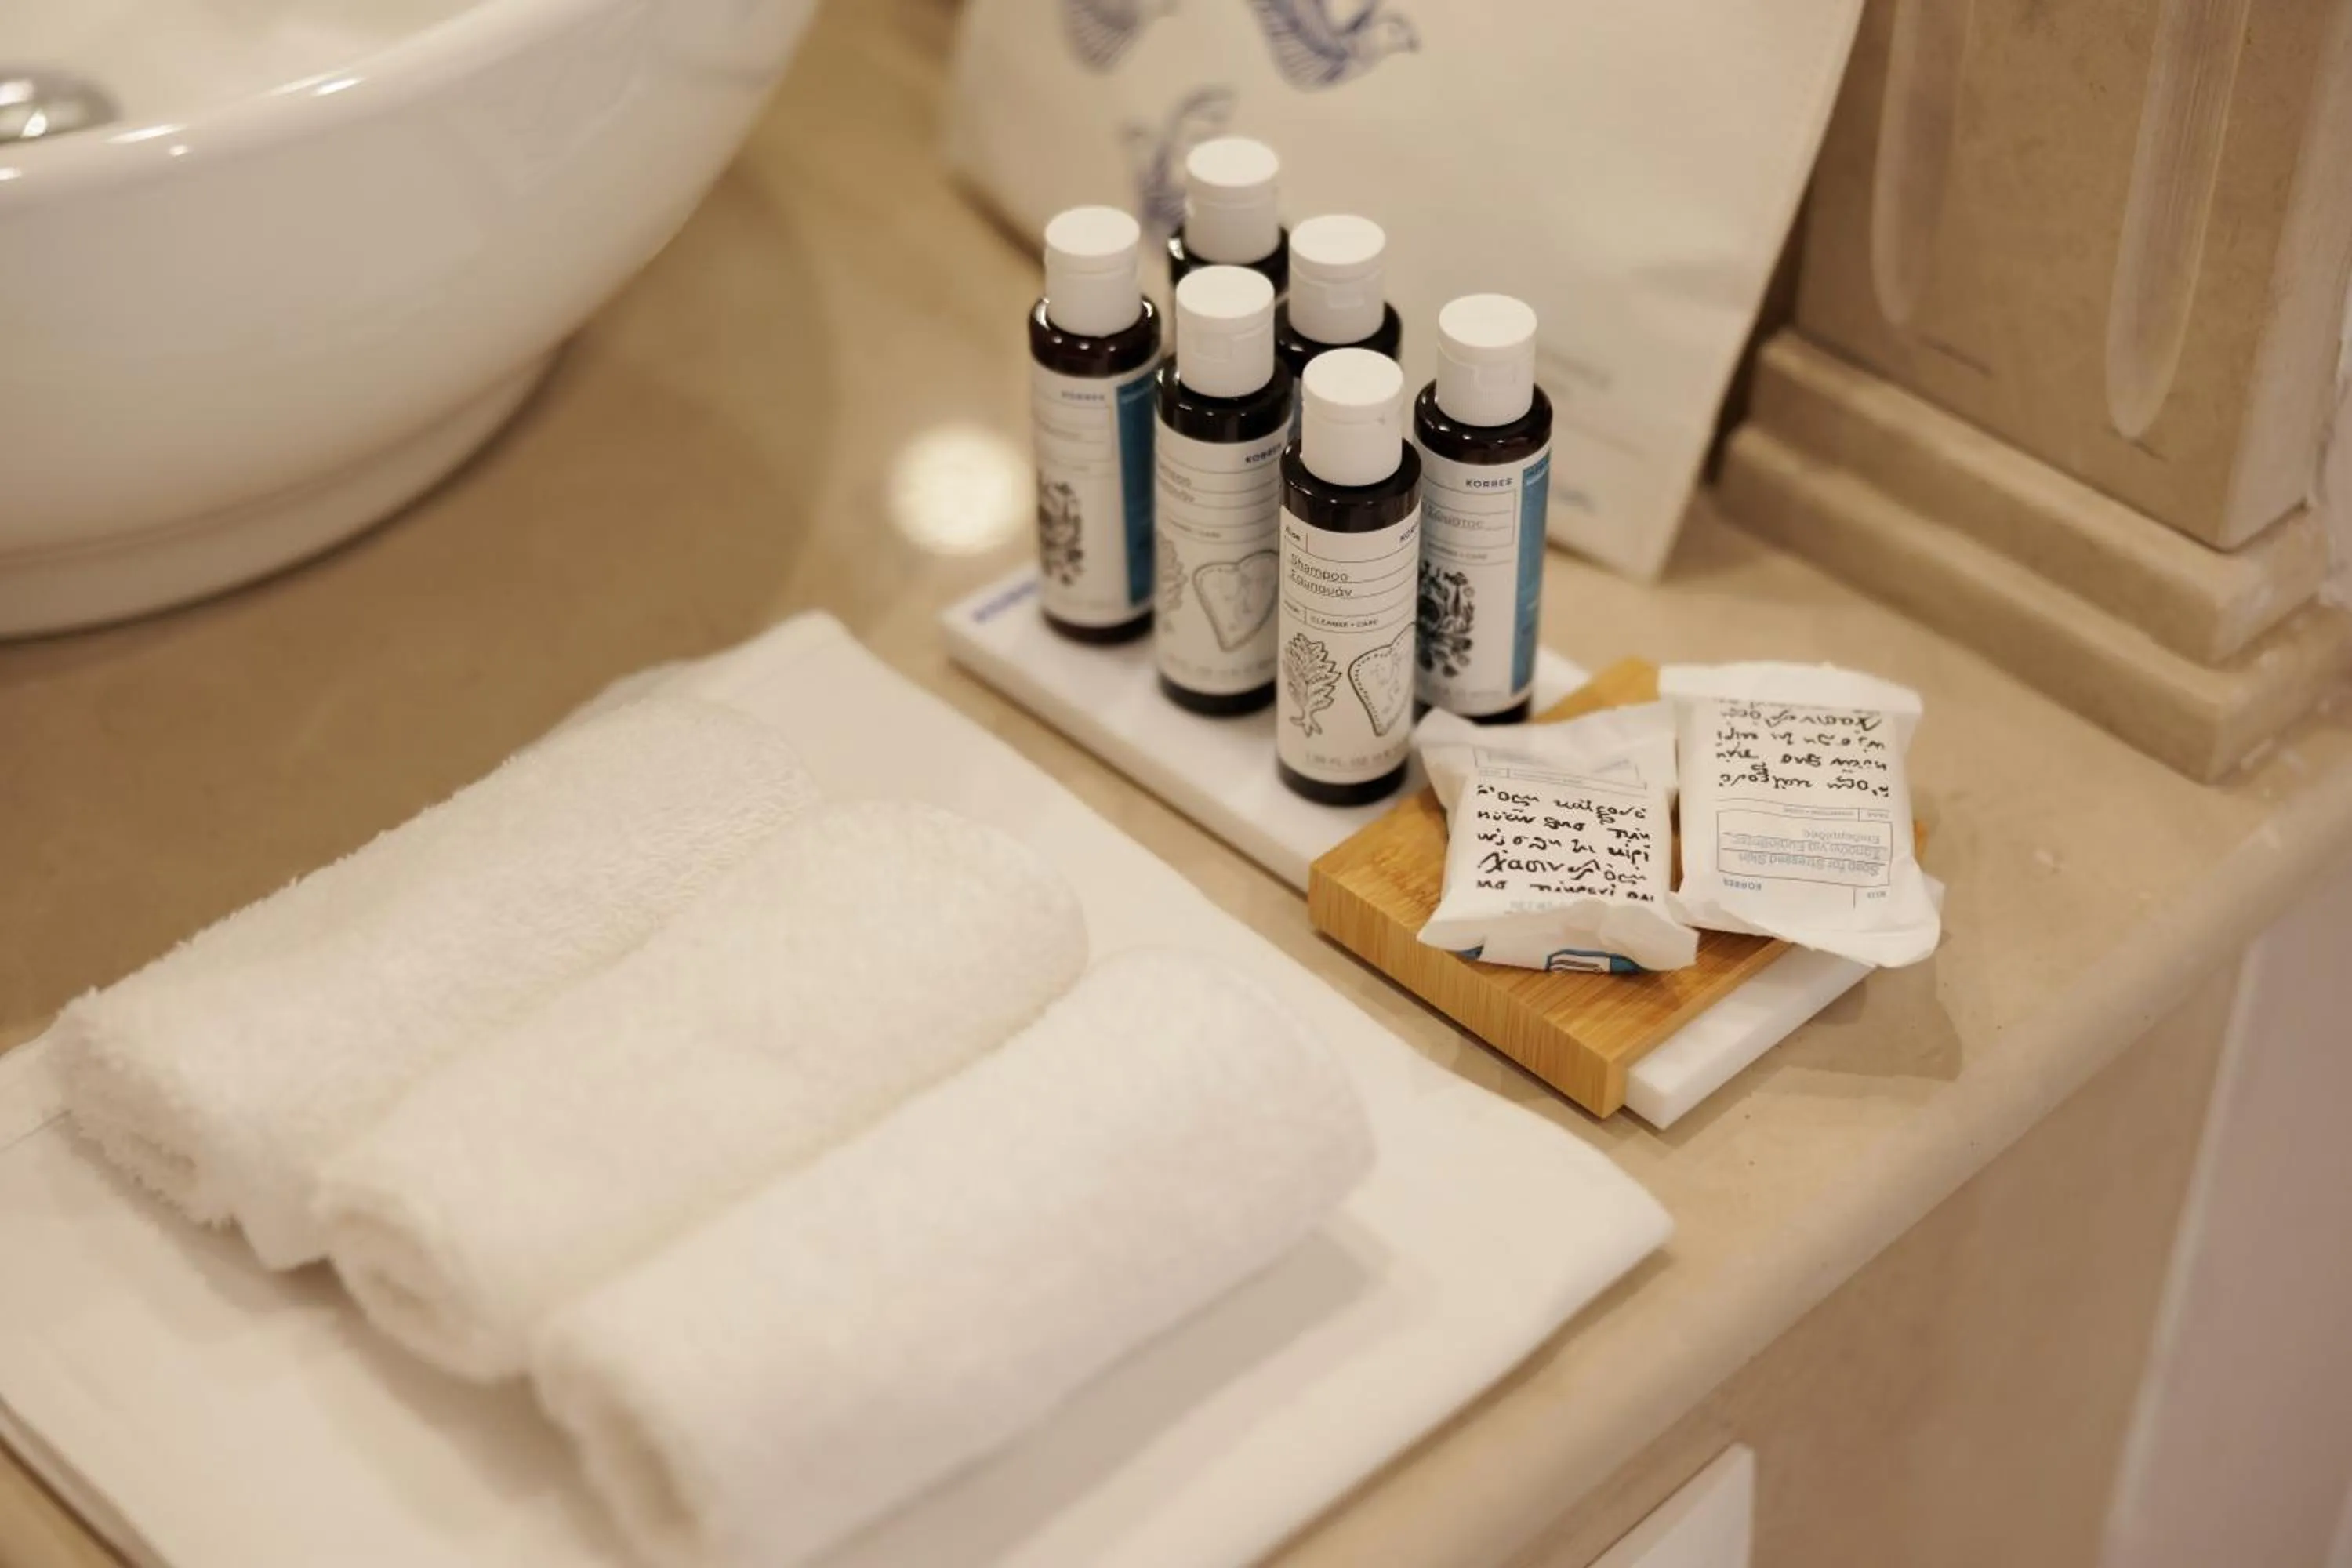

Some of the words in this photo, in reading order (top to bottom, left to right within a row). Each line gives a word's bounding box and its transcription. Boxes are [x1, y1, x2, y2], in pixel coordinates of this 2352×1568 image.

[1465, 477, 1513, 488] KORRES
[1290, 553, 1348, 583] Shampoo
[1739, 852, 1768, 866] Skin
[1828, 862, 1844, 871] for
[1848, 864, 1880, 877] Soap
[1723, 878, 1762, 891] KORRES
